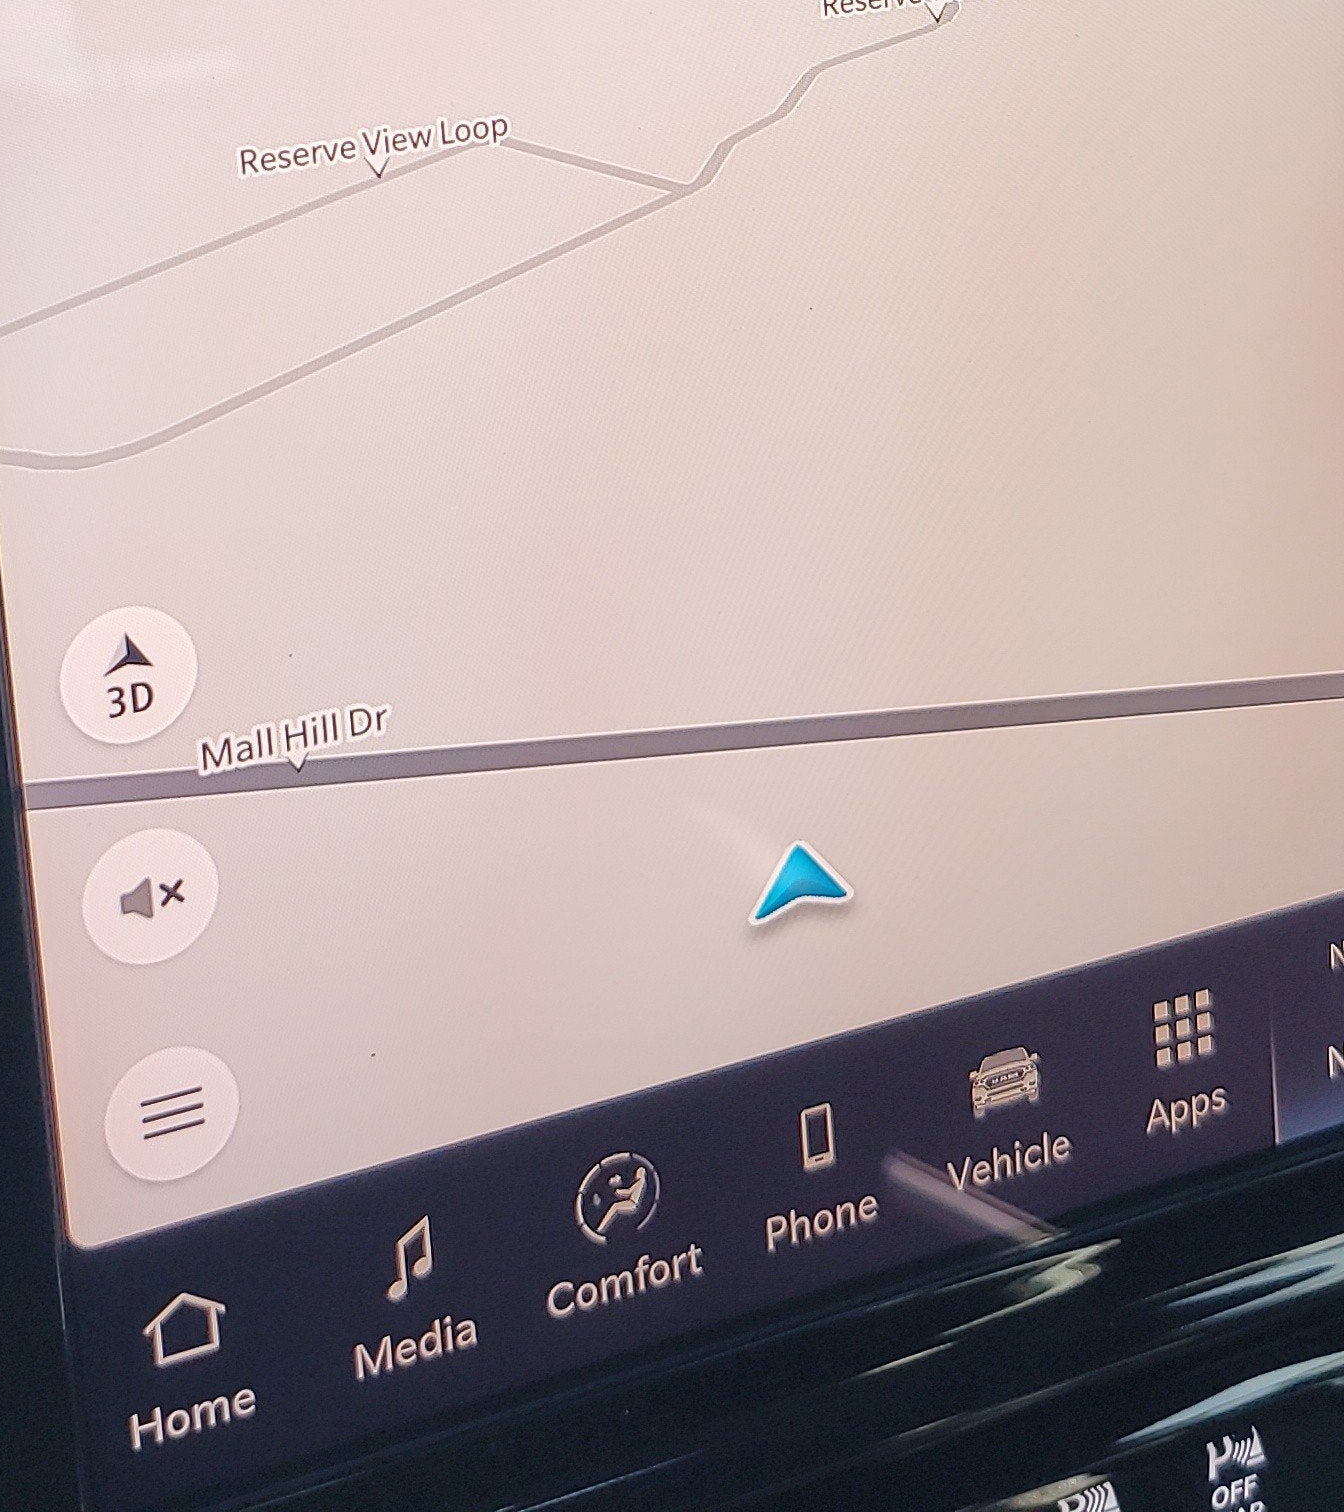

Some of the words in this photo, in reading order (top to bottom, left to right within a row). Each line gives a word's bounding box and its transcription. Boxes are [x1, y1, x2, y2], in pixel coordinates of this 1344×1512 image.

[239, 134, 357, 175] Reserve
[361, 125, 433, 157] View
[439, 115, 510, 146] Loop
[107, 681, 154, 719] 3D
[200, 725, 275, 772] Mall
[285, 712, 340, 753] Hill
[349, 705, 388, 738] Dr
[1146, 1087, 1228, 1134] Apps
[946, 1131, 1073, 1191] Vehicle
[764, 1194, 880, 1253] Phone
[546, 1242, 705, 1319] Comfort
[353, 1315, 480, 1383] Media
[128, 1387, 257, 1453] Home
[1211, 1473, 1259, 1511] OFF
